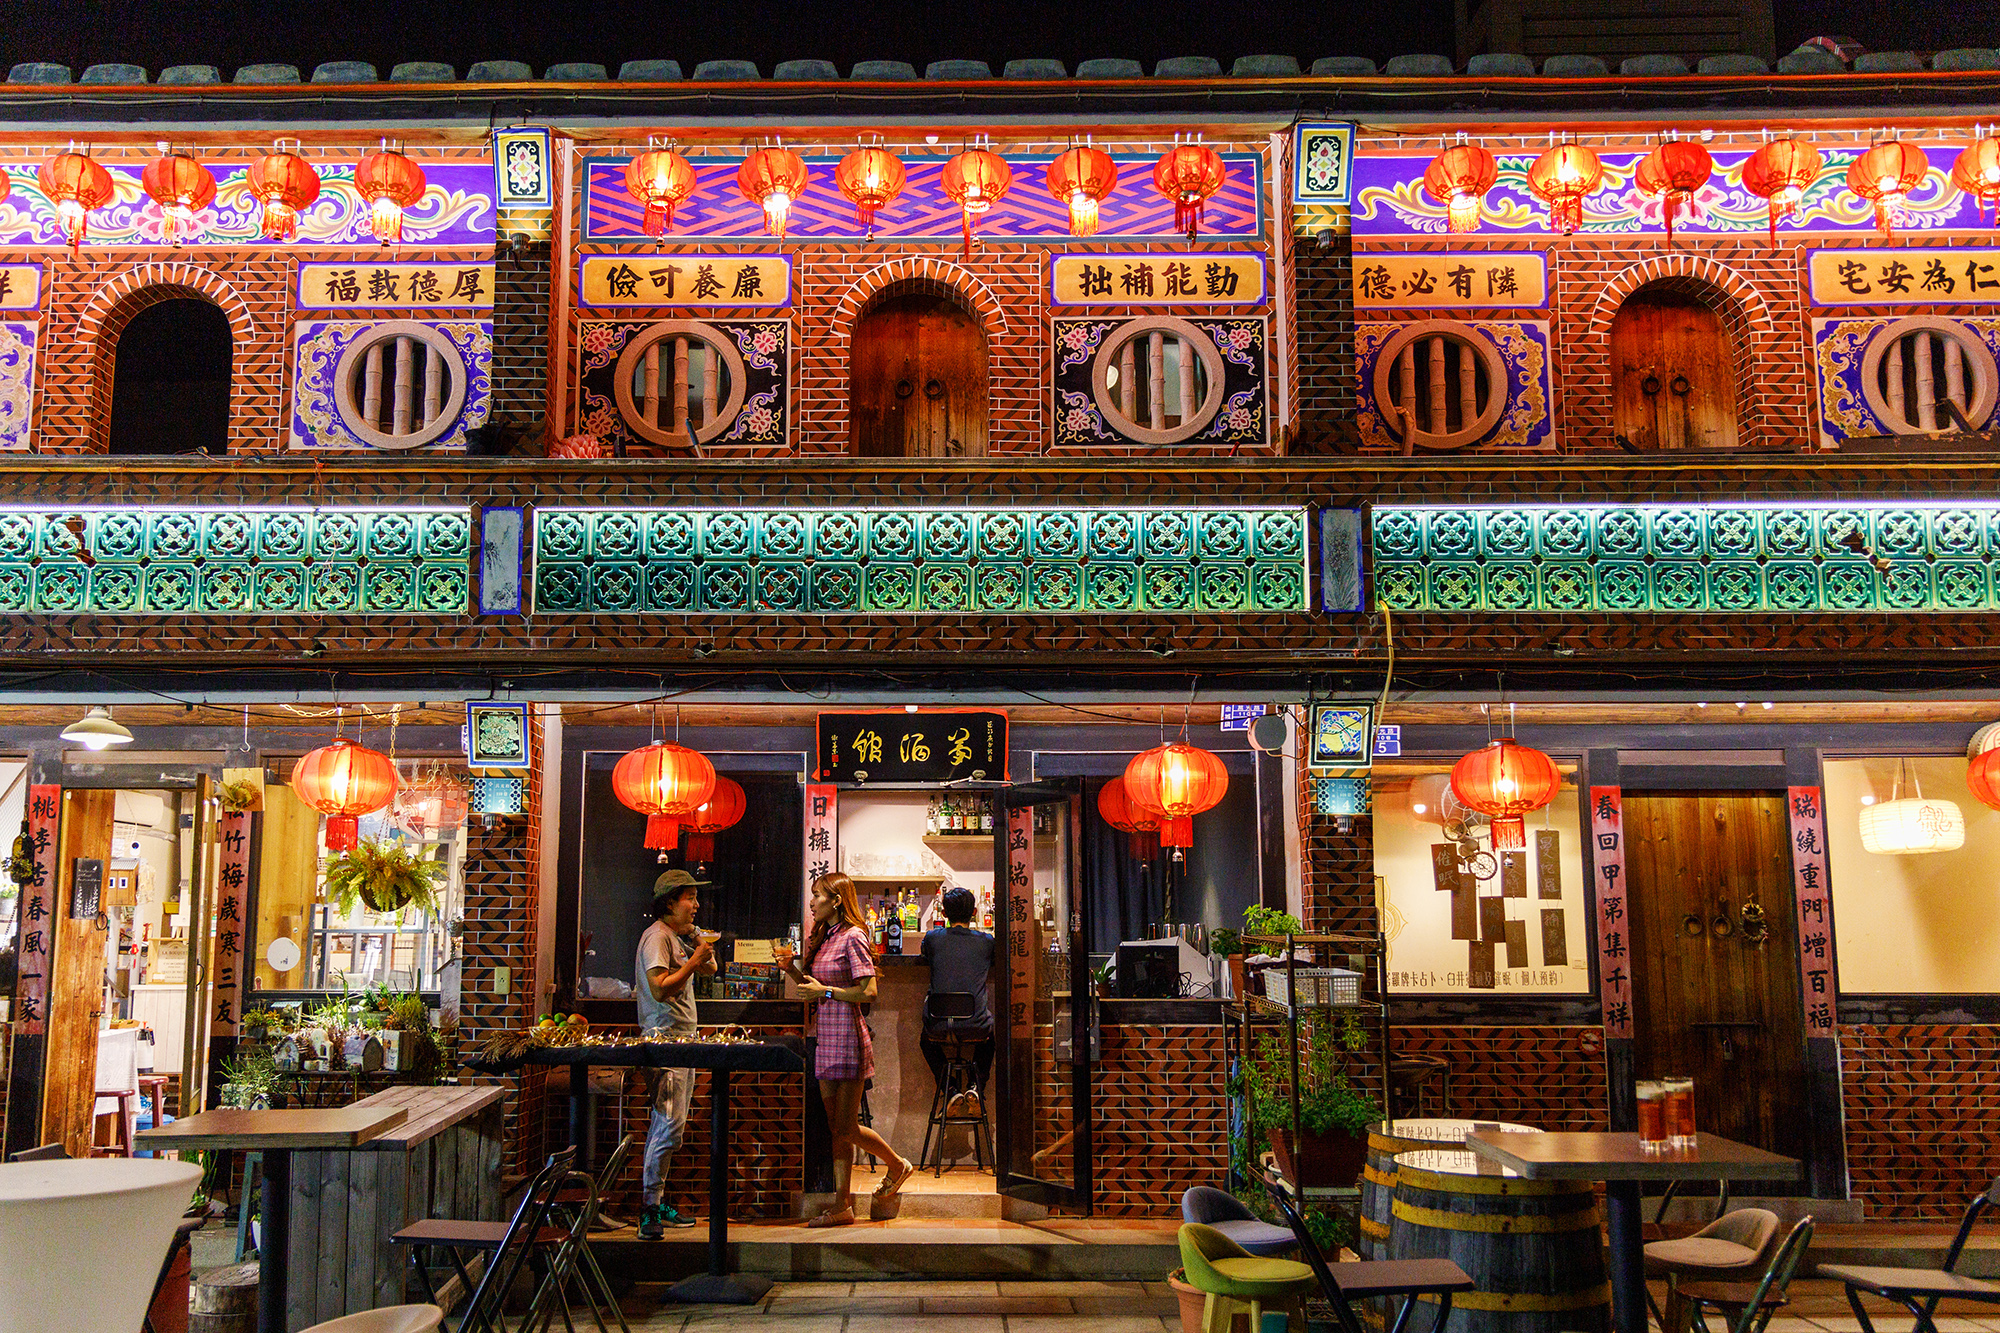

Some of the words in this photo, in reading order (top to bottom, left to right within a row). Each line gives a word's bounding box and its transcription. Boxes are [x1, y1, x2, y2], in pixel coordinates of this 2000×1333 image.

[325, 267, 485, 303] 厚德載福
[606, 263, 763, 299] 儉可養廉
[1079, 262, 1239, 298] 勤能補拙
[1378, 742, 1387, 753] 5
[1342, 800, 1350, 811] 4
[1435, 850, 1459, 886] 催眠
[1596, 795, 1631, 1030] 春回甲第集千祥
[1794, 794, 1833, 1029] 瑞繞重門增百福
